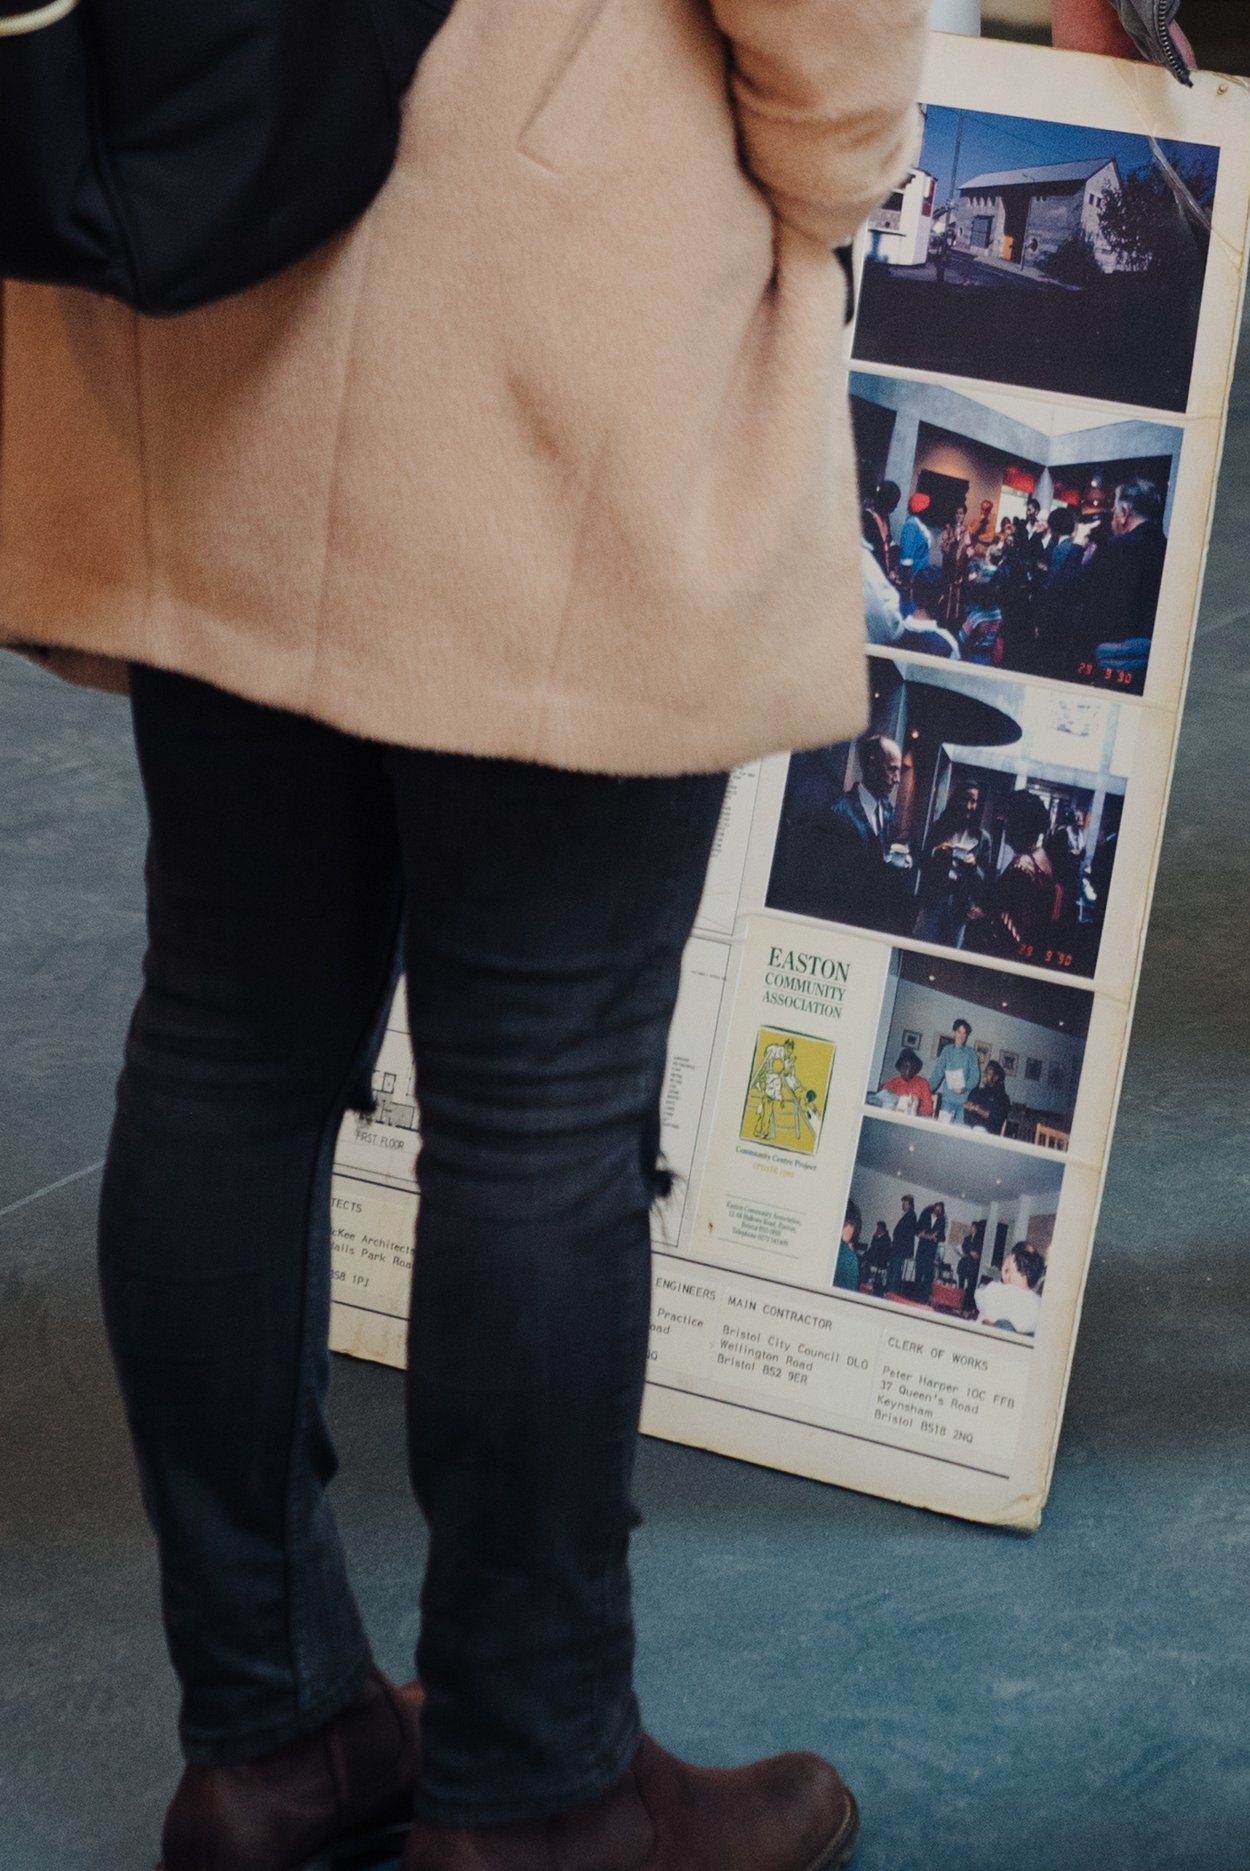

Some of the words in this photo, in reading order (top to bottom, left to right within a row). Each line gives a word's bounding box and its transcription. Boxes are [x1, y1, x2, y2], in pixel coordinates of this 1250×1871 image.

[768, 946, 851, 983] EASTON
[764, 971, 846, 1001] COMMUNITY
[762, 990, 843, 1019] ASSOCIATION
[356, 1130, 377, 1145] FIRST
[380, 1137, 405, 1150] FLOOR
[736, 1145, 770, 1162] Community
[772, 1154, 794, 1166] Centre
[331, 1197, 363, 1213] TECTS
[331, 1228, 356, 1241] cKee
[332, 1242, 356, 1256] alls
[360, 1249, 386, 1262] Park
[392, 1256, 412, 1269] Roa
[656, 1276, 716, 1301] ENGINEERS
[658, 1308, 704, 1328] Practice
[728, 1296, 757, 1312] MAIN
[762, 1304, 833, 1330] CONTRACTOR
[649, 1323, 671, 1335] oad
[720, 1339, 779, 1362] Wellington
[786, 1356, 814, 1372] Road
[722, 1324, 761, 1342] Bristol
[768, 1335, 791, 1352] City
[798, 1343, 840, 1364] Council
[846, 1356, 869, 1370] DLO
[888, 1336, 924, 1354] CLERK
[930, 1348, 945, 1360] OF
[952, 1352, 988, 1372] WORKS
[717, 1353, 755, 1372] Bristol
[762, 1366, 782, 1378] BS2
[787, 1371, 808, 1385] 9ER
[882, 1365, 912, 1382] Peter
[919, 1376, 959, 1394] Harper
[877, 1394, 934, 1418] Keynsham
[880, 1380, 893, 1392] 37
[898, 1385, 944, 1406] Queen's
[950, 1398, 979, 1415] Road
[874, 1408, 914, 1428] Bristol
